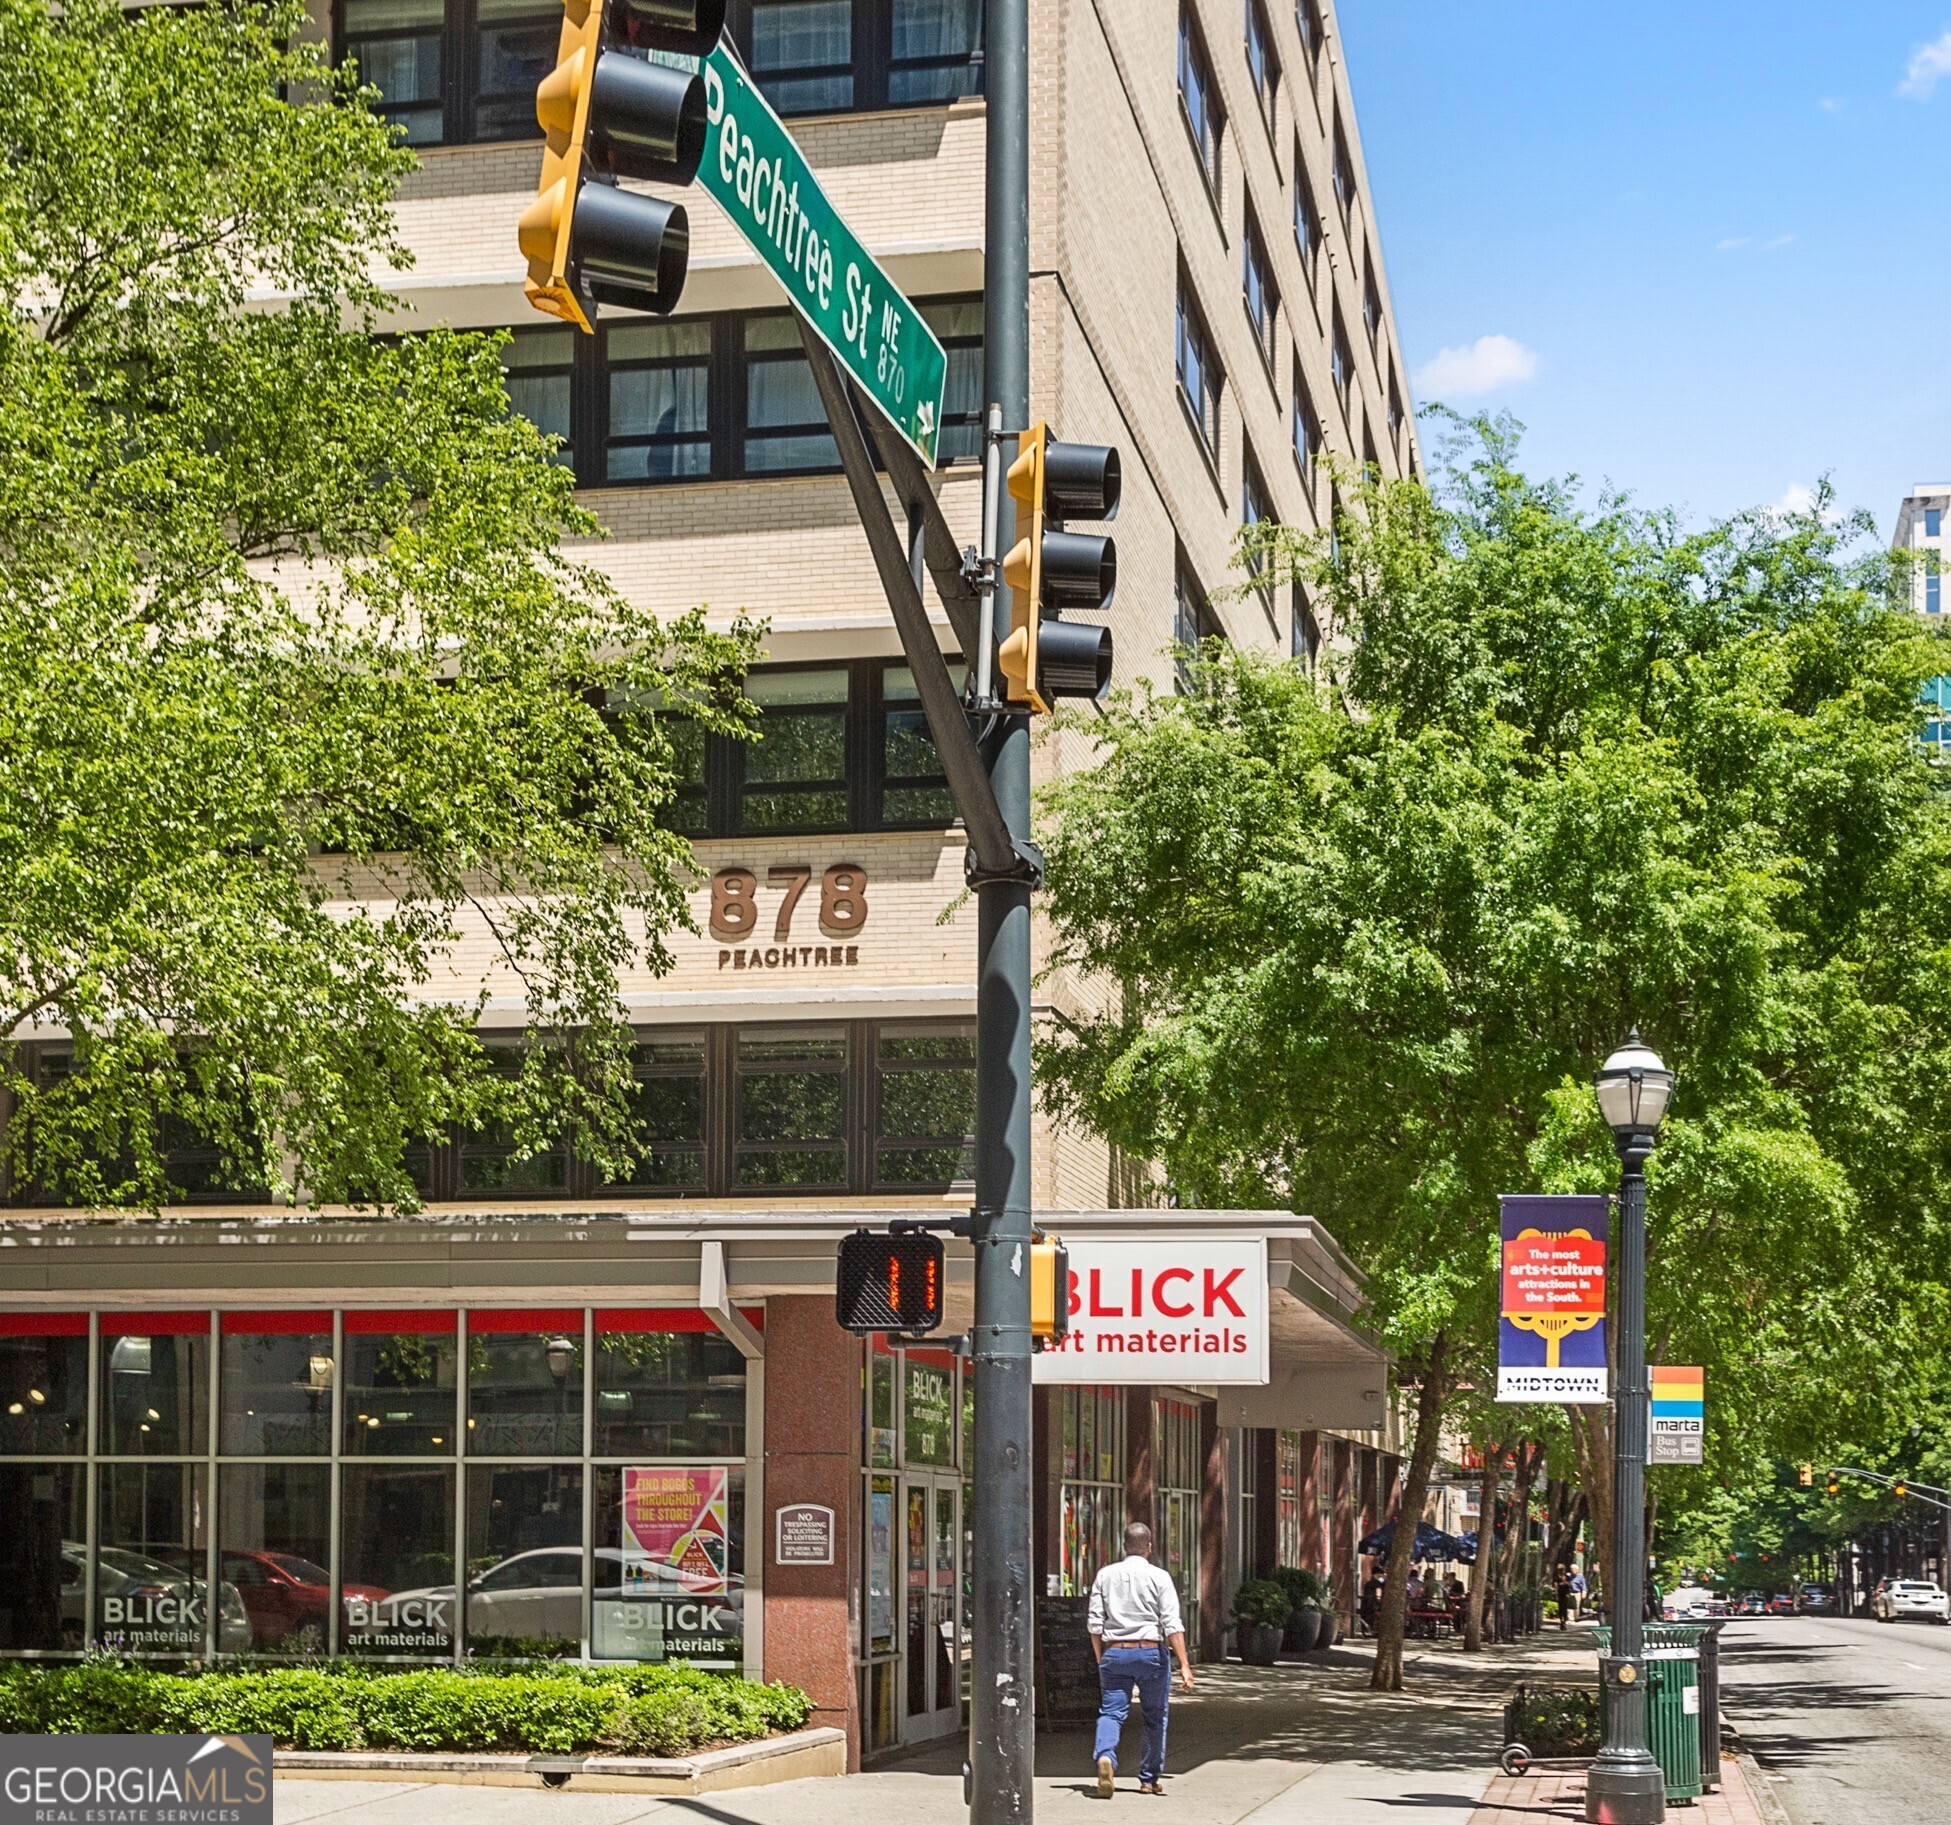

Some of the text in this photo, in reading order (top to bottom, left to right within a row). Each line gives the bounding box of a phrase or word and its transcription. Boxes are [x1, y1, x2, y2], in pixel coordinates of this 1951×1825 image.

[704, 61, 872, 360] Peachtree St
[882, 299, 902, 354] NE
[877, 342, 905, 404] 870
[709, 864, 868, 935] 878
[718, 945, 859, 971] PEACHTREE
[1529, 1249, 1580, 1259] The most
[1509, 1261, 1604, 1276] arts+culture
[888, 1254, 937, 1313] 11
[1517, 1279, 1590, 1289] attractions in
[1525, 1292, 1582, 1302] the South.
[1096, 1328, 1248, 1353] materials
[912, 1371, 943, 1403] BLICK
[1507, 1378, 1598, 1391] MIDTOWN
[1656, 1420, 1700, 1431] marta
[1656, 1436, 1676, 1445] Bus
[1656, 1446, 1680, 1458] Stop
[636, 1478, 659, 1491] FIND
[637, 1493, 702, 1506] THROUGHOUT
[636, 1508, 693, 1521] THE STORE!
[797, 1513, 813, 1521] NO
[104, 1597, 200, 1624] BLICK
[349, 1600, 447, 1628] BLICK
[624, 1603, 723, 1631] BLICK
[104, 1628, 201, 1642] art materials
[347, 1632, 449, 1646] art materials
